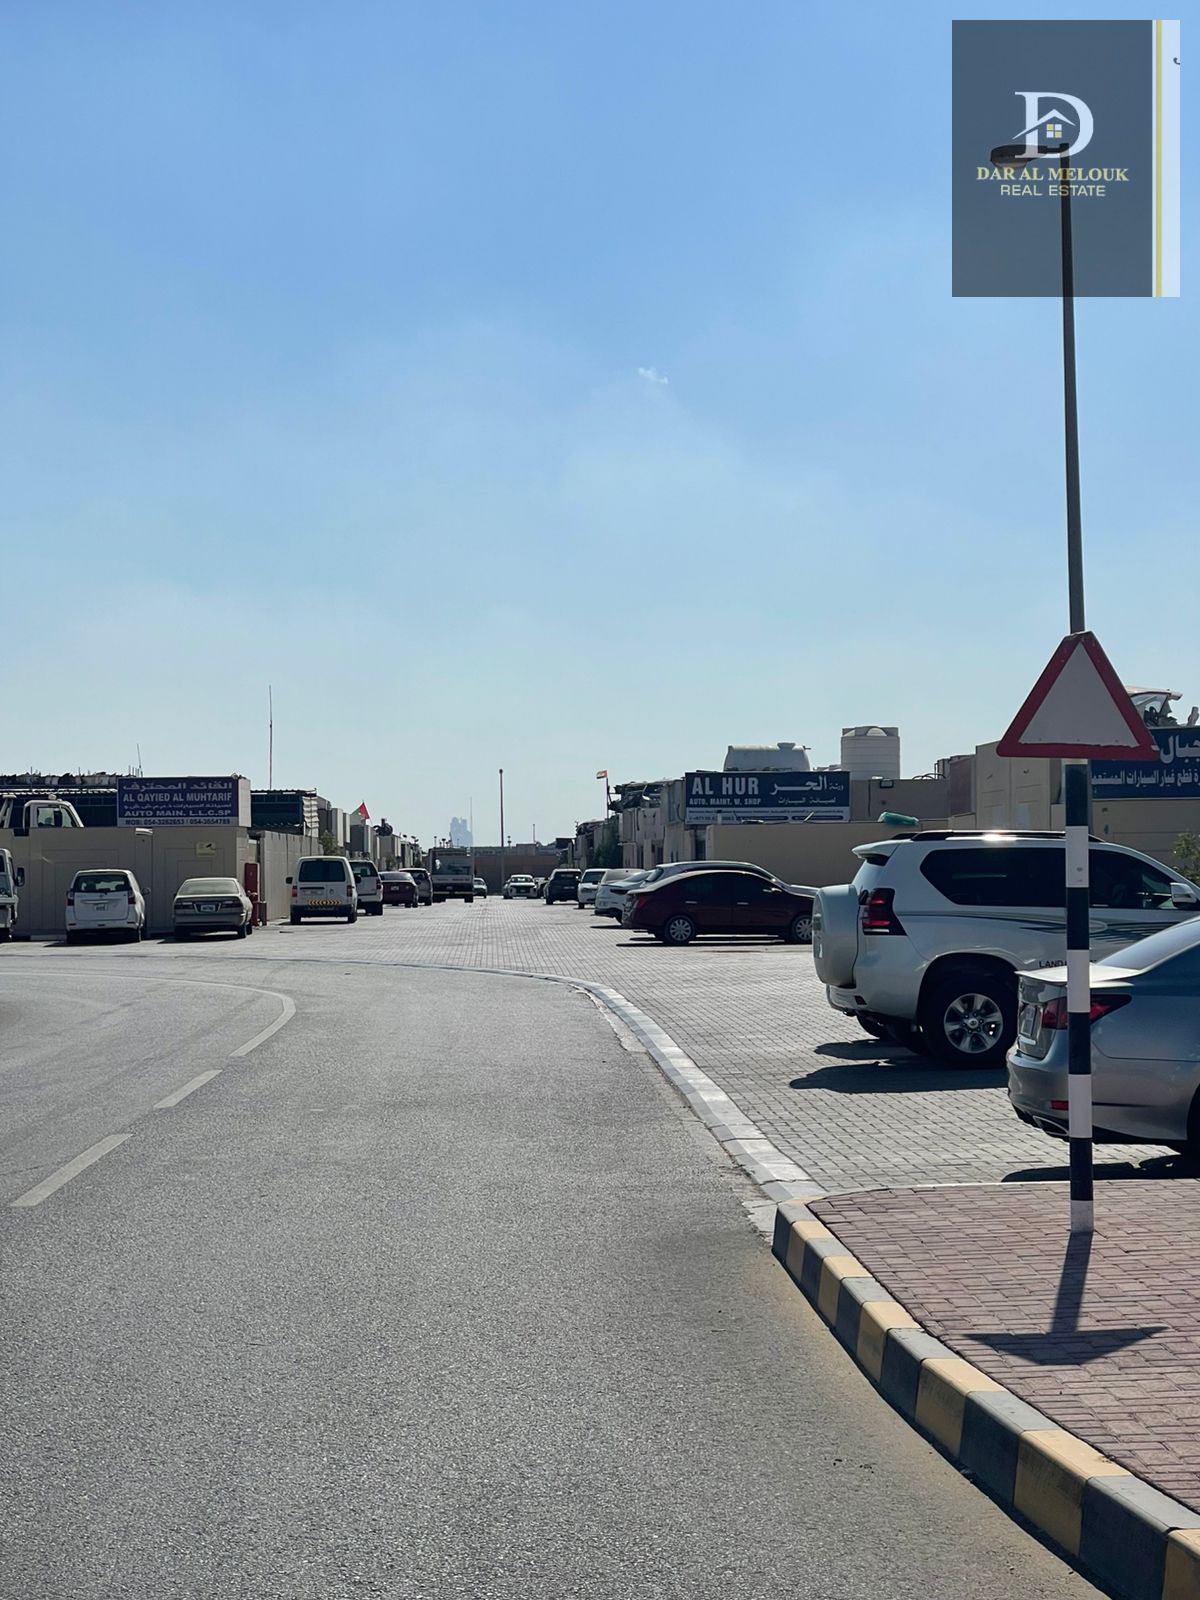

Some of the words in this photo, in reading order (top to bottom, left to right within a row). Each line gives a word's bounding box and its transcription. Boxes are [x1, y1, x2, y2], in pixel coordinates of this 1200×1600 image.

[123, 782, 187, 792] المحترف
[190, 781, 233, 790] القائد
[692, 777, 714, 795] AL
[722, 777, 759, 795] HUR
[769, 775, 828, 796] الحر
[1126, 770, 1159, 788] السيارات
[1160, 769, 1175, 787] غيار
[1176, 769, 1193, 787] قطع
[123, 793, 135, 802] AL
[137, 793, 170, 802] QAYIED
[173, 793, 184, 802] AL
[186, 792, 233, 802] MUHTARIF
[744, 798, 761, 806] SHOP
